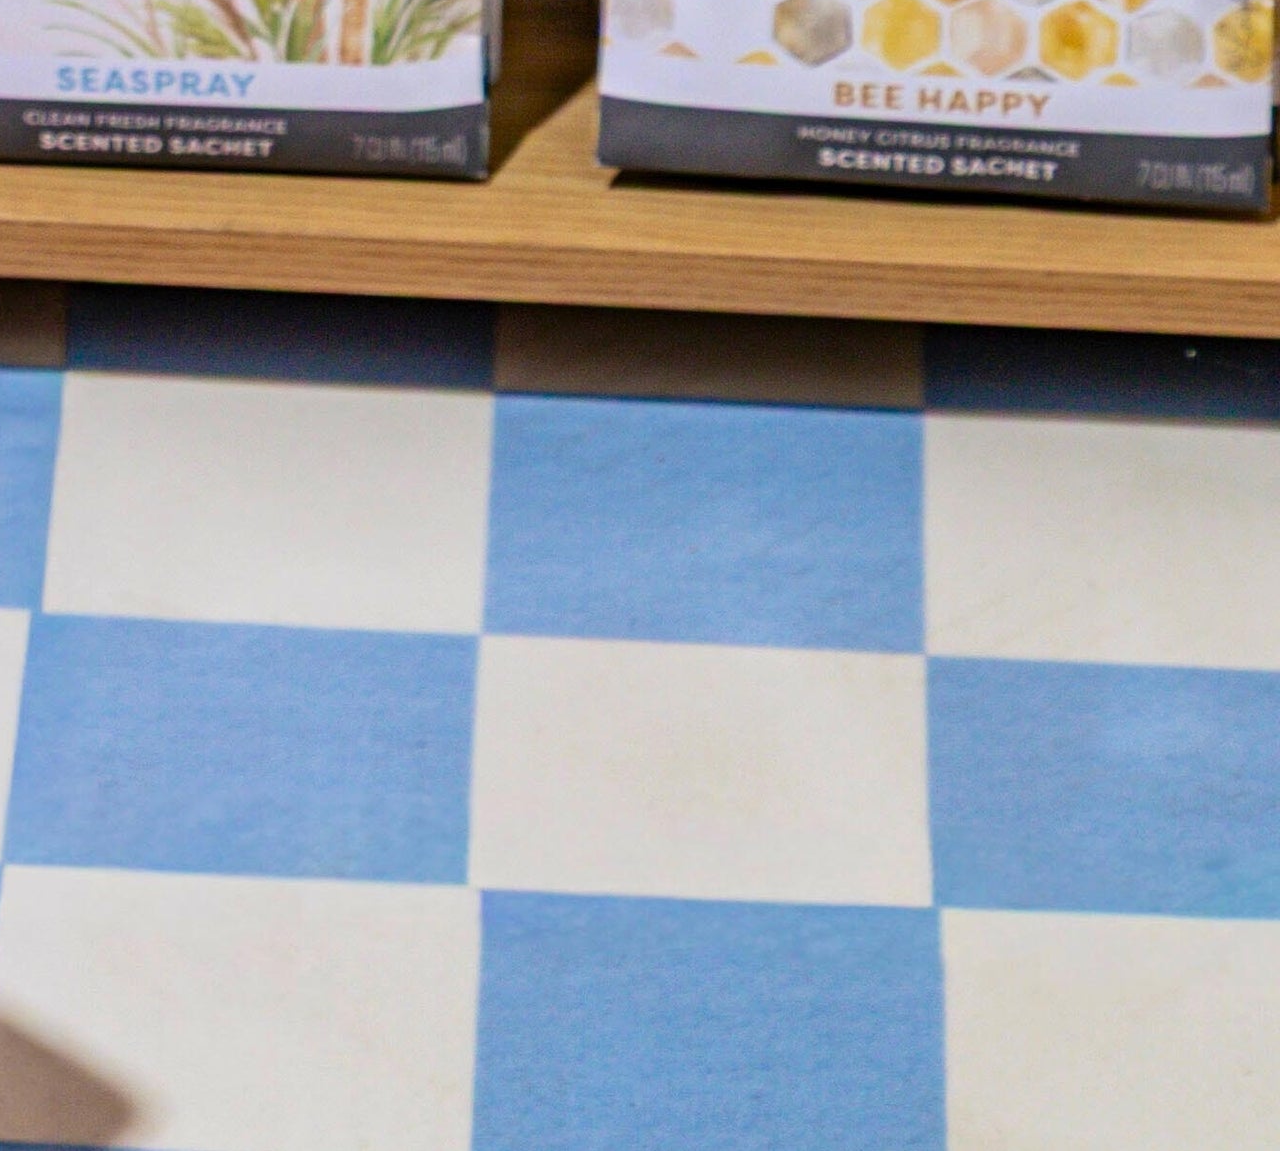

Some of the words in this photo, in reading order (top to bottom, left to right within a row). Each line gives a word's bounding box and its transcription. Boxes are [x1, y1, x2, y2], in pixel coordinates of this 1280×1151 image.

[54, 66, 257, 98] SEASPRAY
[833, 83, 905, 111] BEE
[915, 87, 1052, 118] HAPPY
[38, 131, 163, 154] SCENTED
[167, 134, 275, 158] SACHET
[819, 147, 947, 175] SCENTED
[950, 156, 1059, 182] SACHET
